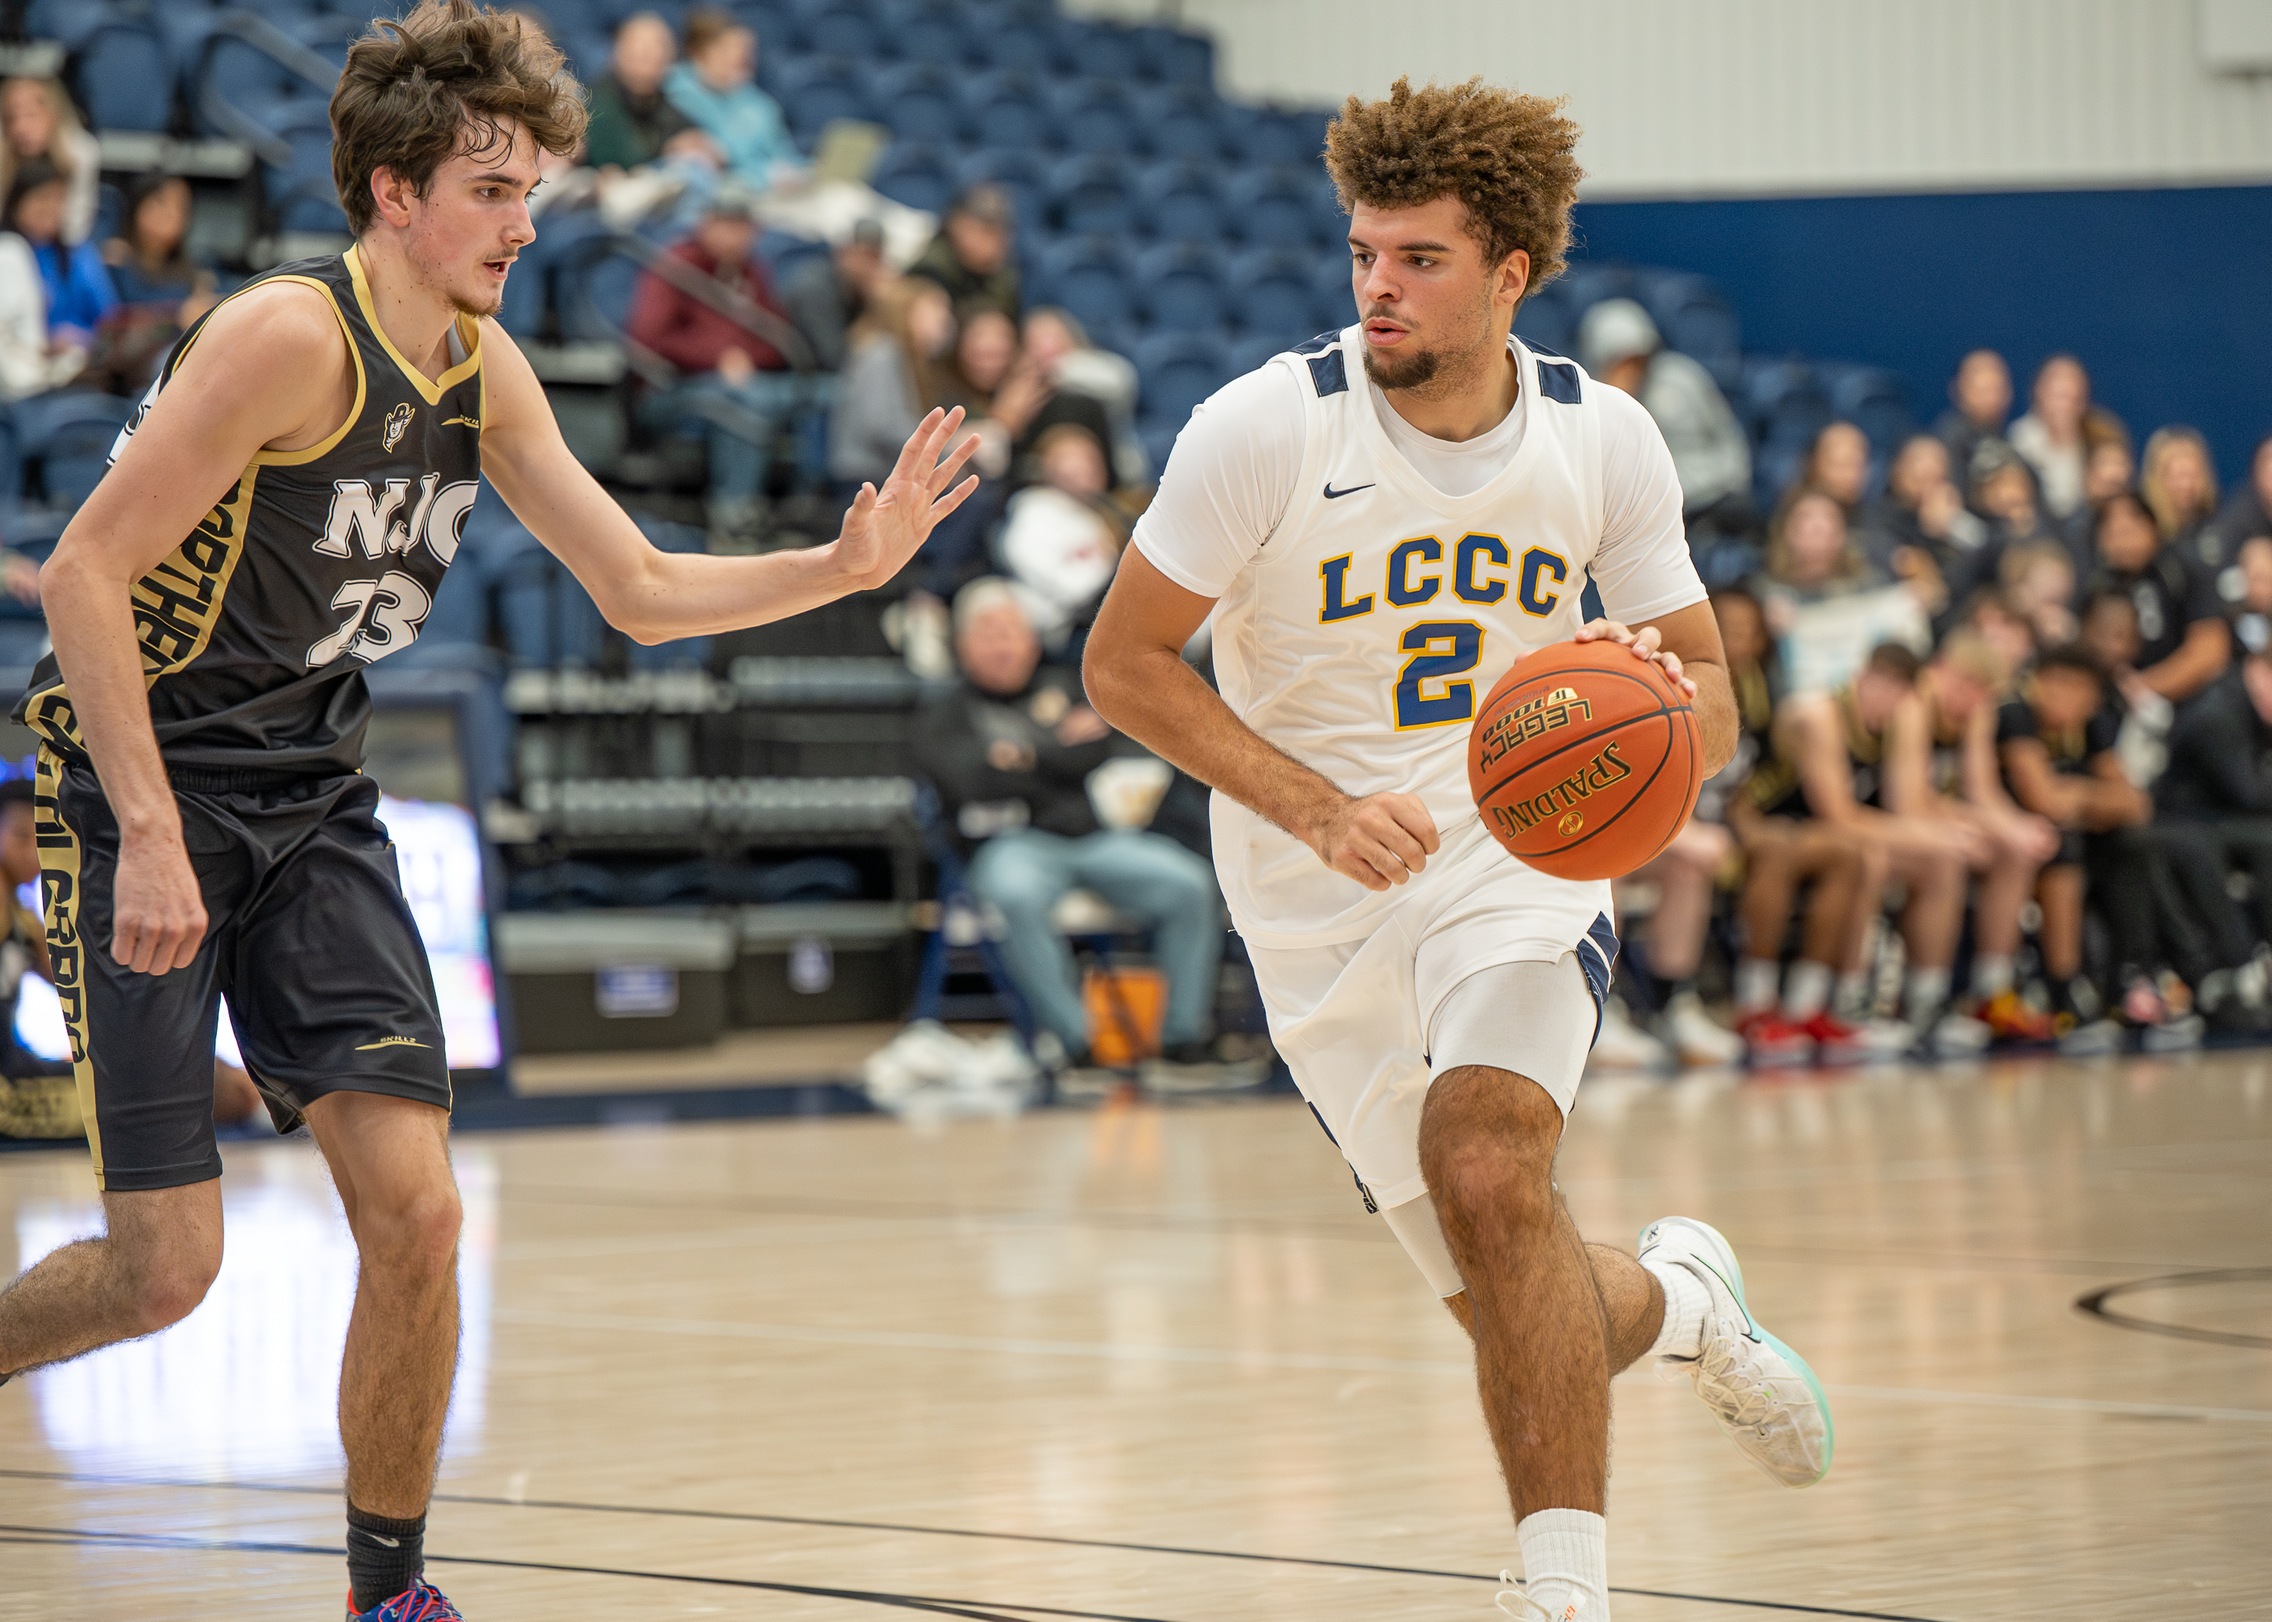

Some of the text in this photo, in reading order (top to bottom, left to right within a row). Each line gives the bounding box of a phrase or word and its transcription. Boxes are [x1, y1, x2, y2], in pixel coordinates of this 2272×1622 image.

[1318, 531, 1569, 625] LCCC
[1392, 619, 1488, 732] 2
[1482, 697, 1545, 743] 1000
[1480, 698, 1593, 775] LEGACY
[1491, 740, 1632, 841] SPALDING
